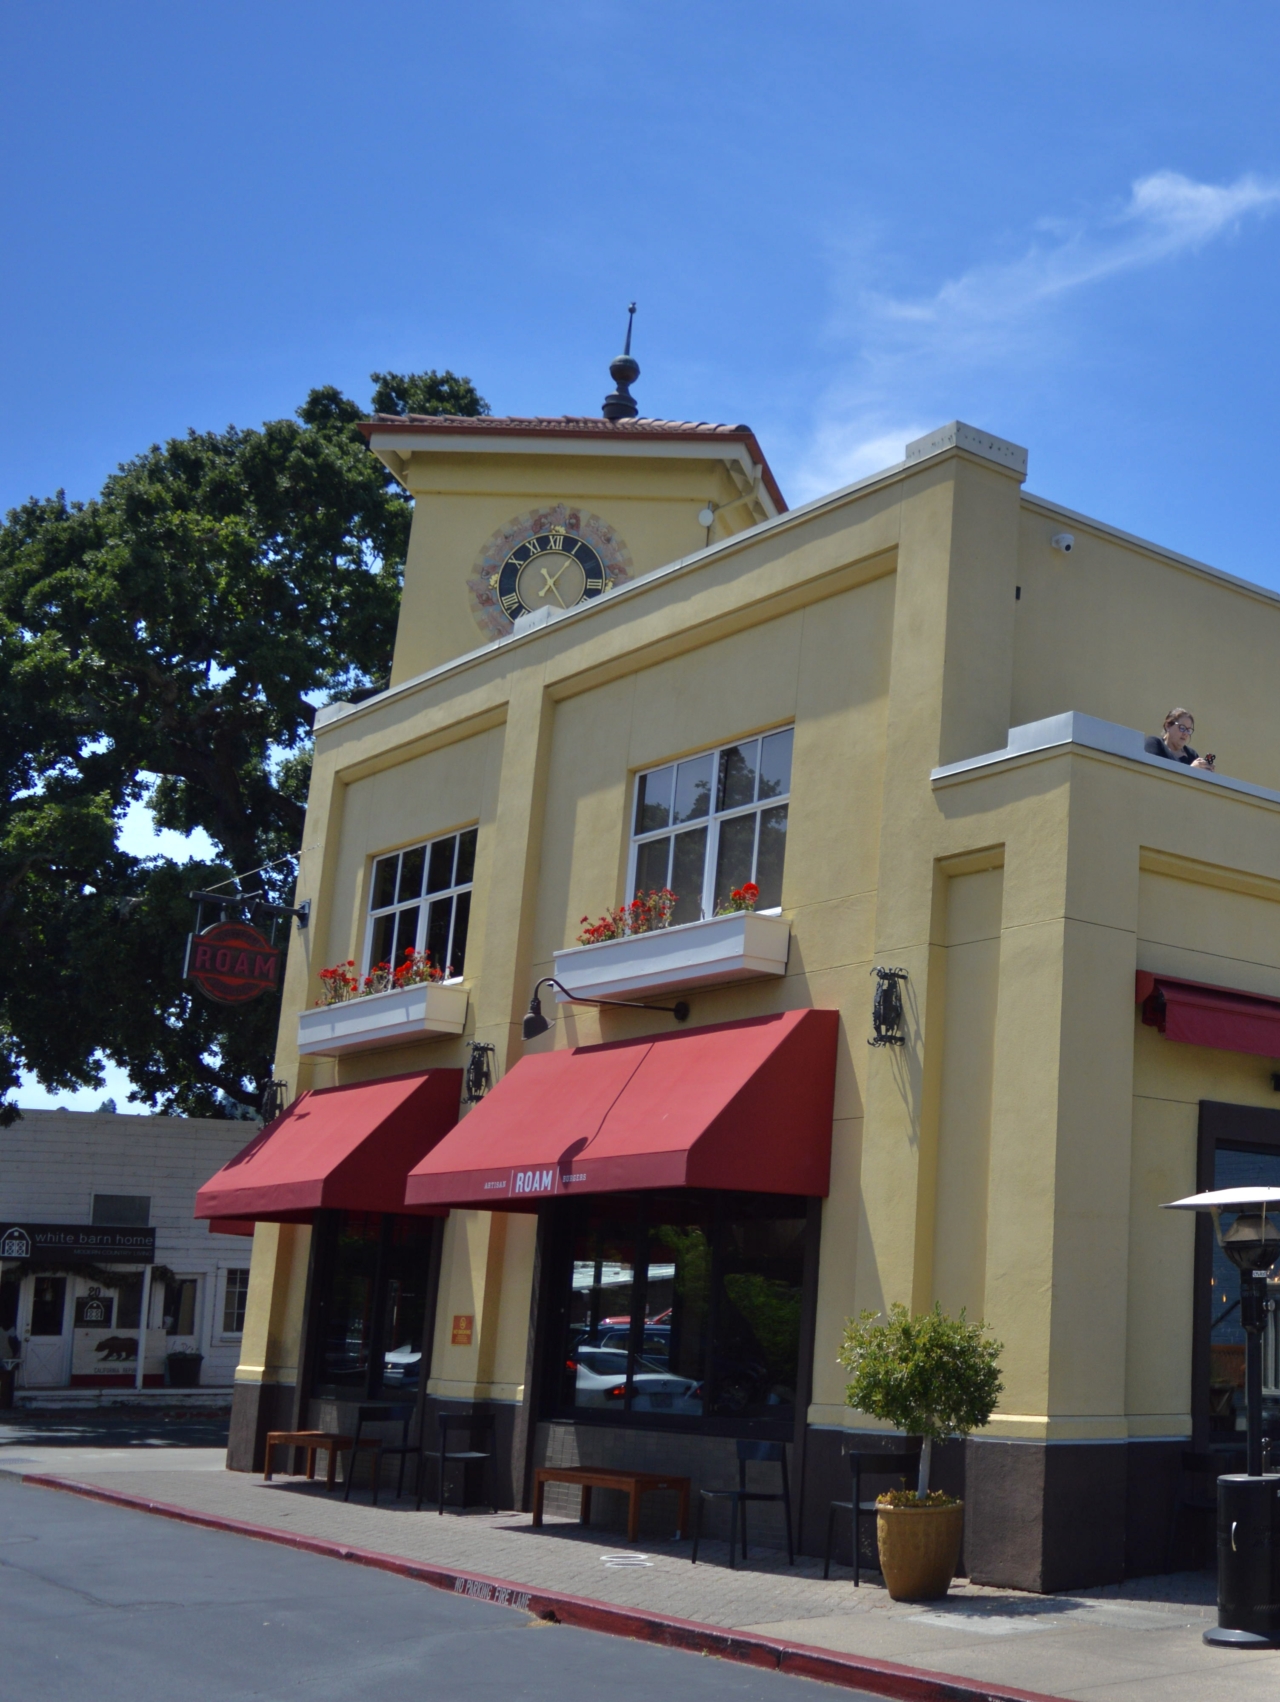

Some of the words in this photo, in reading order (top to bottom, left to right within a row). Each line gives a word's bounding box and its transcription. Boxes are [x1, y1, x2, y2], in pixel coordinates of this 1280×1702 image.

[547, 535, 564, 550] XII
[195, 946, 276, 979] ROAM
[484, 1181, 506, 1189] ARTISAN
[515, 1170, 553, 1193] ROAM
[562, 1173, 587, 1183] BURGERS
[35, 1232, 74, 1243] white
[79, 1233, 111, 1244] barn
[116, 1234, 153, 1245] home
[88, 1286, 101, 1297] 20
[454, 1577, 465, 1593] NO
[465, 1580, 493, 1600] PARKING
[494, 1587, 511, 1605] FIRE
[511, 1591, 532, 1610] LANE
